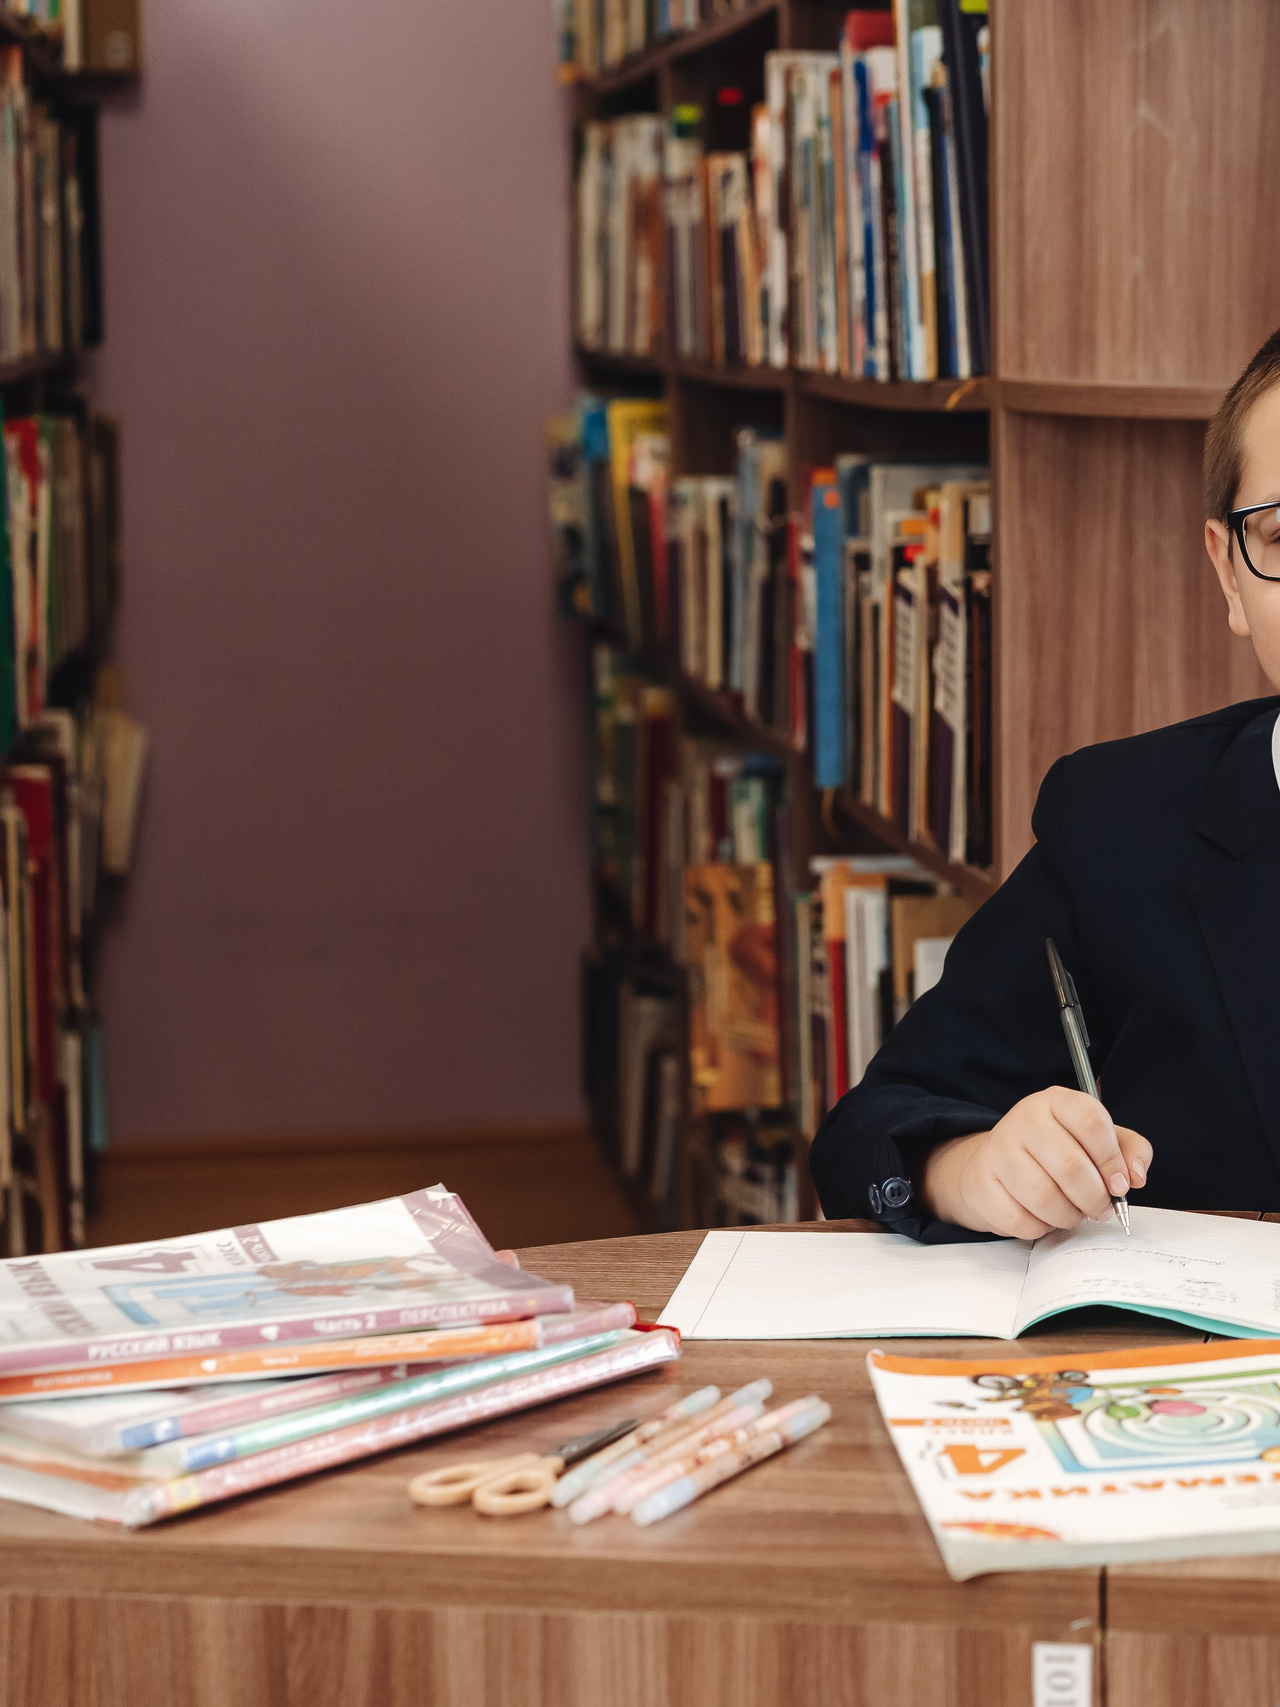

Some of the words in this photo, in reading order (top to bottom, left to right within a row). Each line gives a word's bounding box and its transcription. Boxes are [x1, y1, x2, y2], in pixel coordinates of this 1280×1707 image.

[92, 1252, 197, 1274] 4
[313, 1317, 362, 1334] Часть
[365, 1314, 377, 1330] 2
[400, 1301, 512, 1324] ПЕРСПЕКТИВА
[88, 1336, 169, 1360] РУССКИЙ
[172, 1331, 221, 1350] ЯЗЫК
[938, 1444, 1026, 1475] 4
